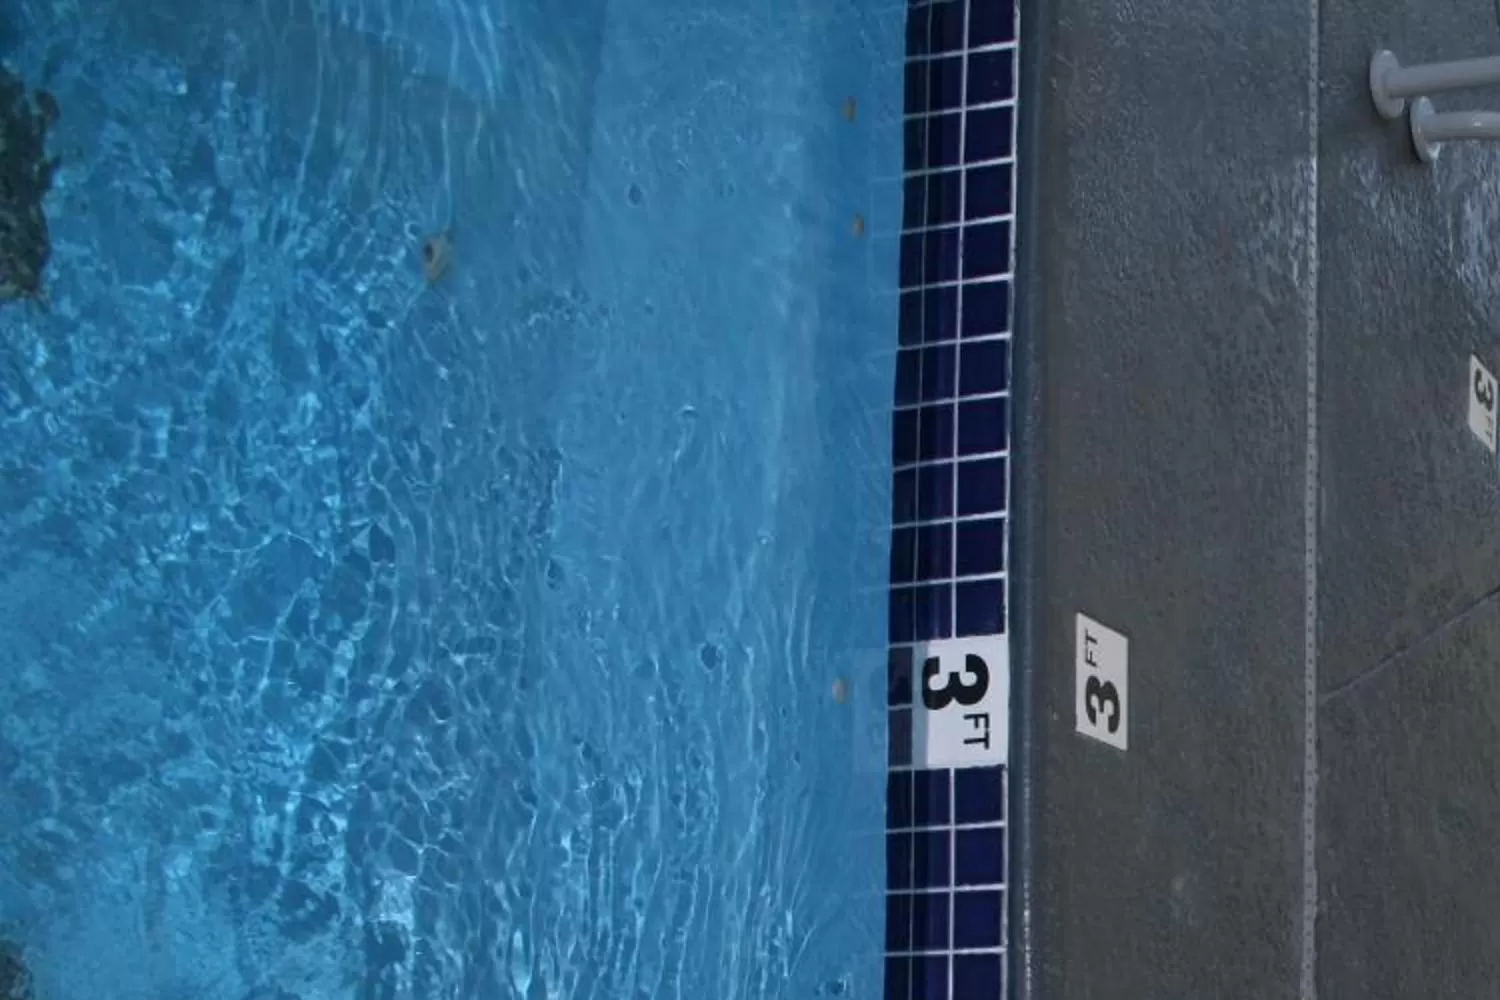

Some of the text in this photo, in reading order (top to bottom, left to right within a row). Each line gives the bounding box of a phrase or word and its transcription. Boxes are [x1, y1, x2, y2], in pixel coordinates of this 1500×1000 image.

[1475, 367, 1495, 412] 3
[922, 653, 990, 750] 3 FT
[1084, 628, 1121, 734] 3 FT
